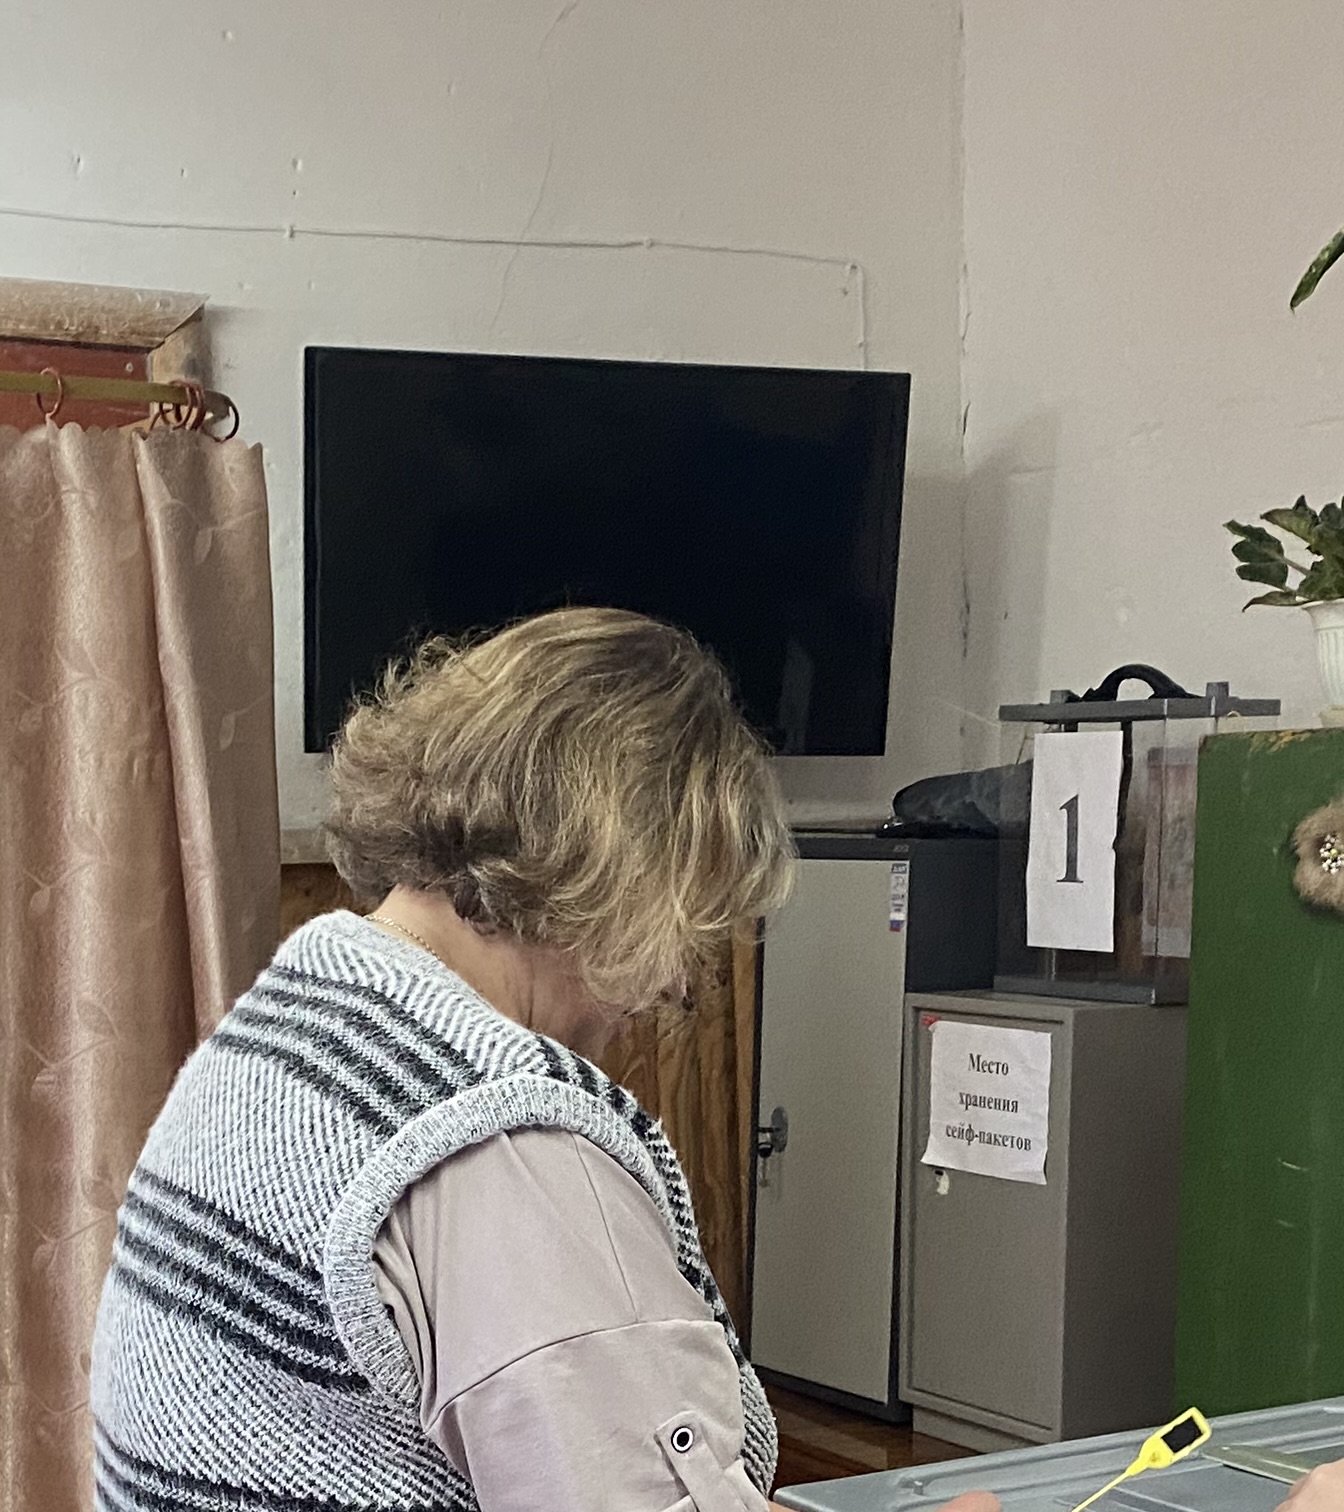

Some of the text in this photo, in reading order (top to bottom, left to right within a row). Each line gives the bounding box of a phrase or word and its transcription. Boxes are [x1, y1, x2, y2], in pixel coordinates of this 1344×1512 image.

[1056, 793, 1084, 884] 1
[968, 1053, 1009, 1075] Место
[958, 1092, 1019, 1113] хранения
[945, 1122, 1032, 1151] сейф-пакетов
